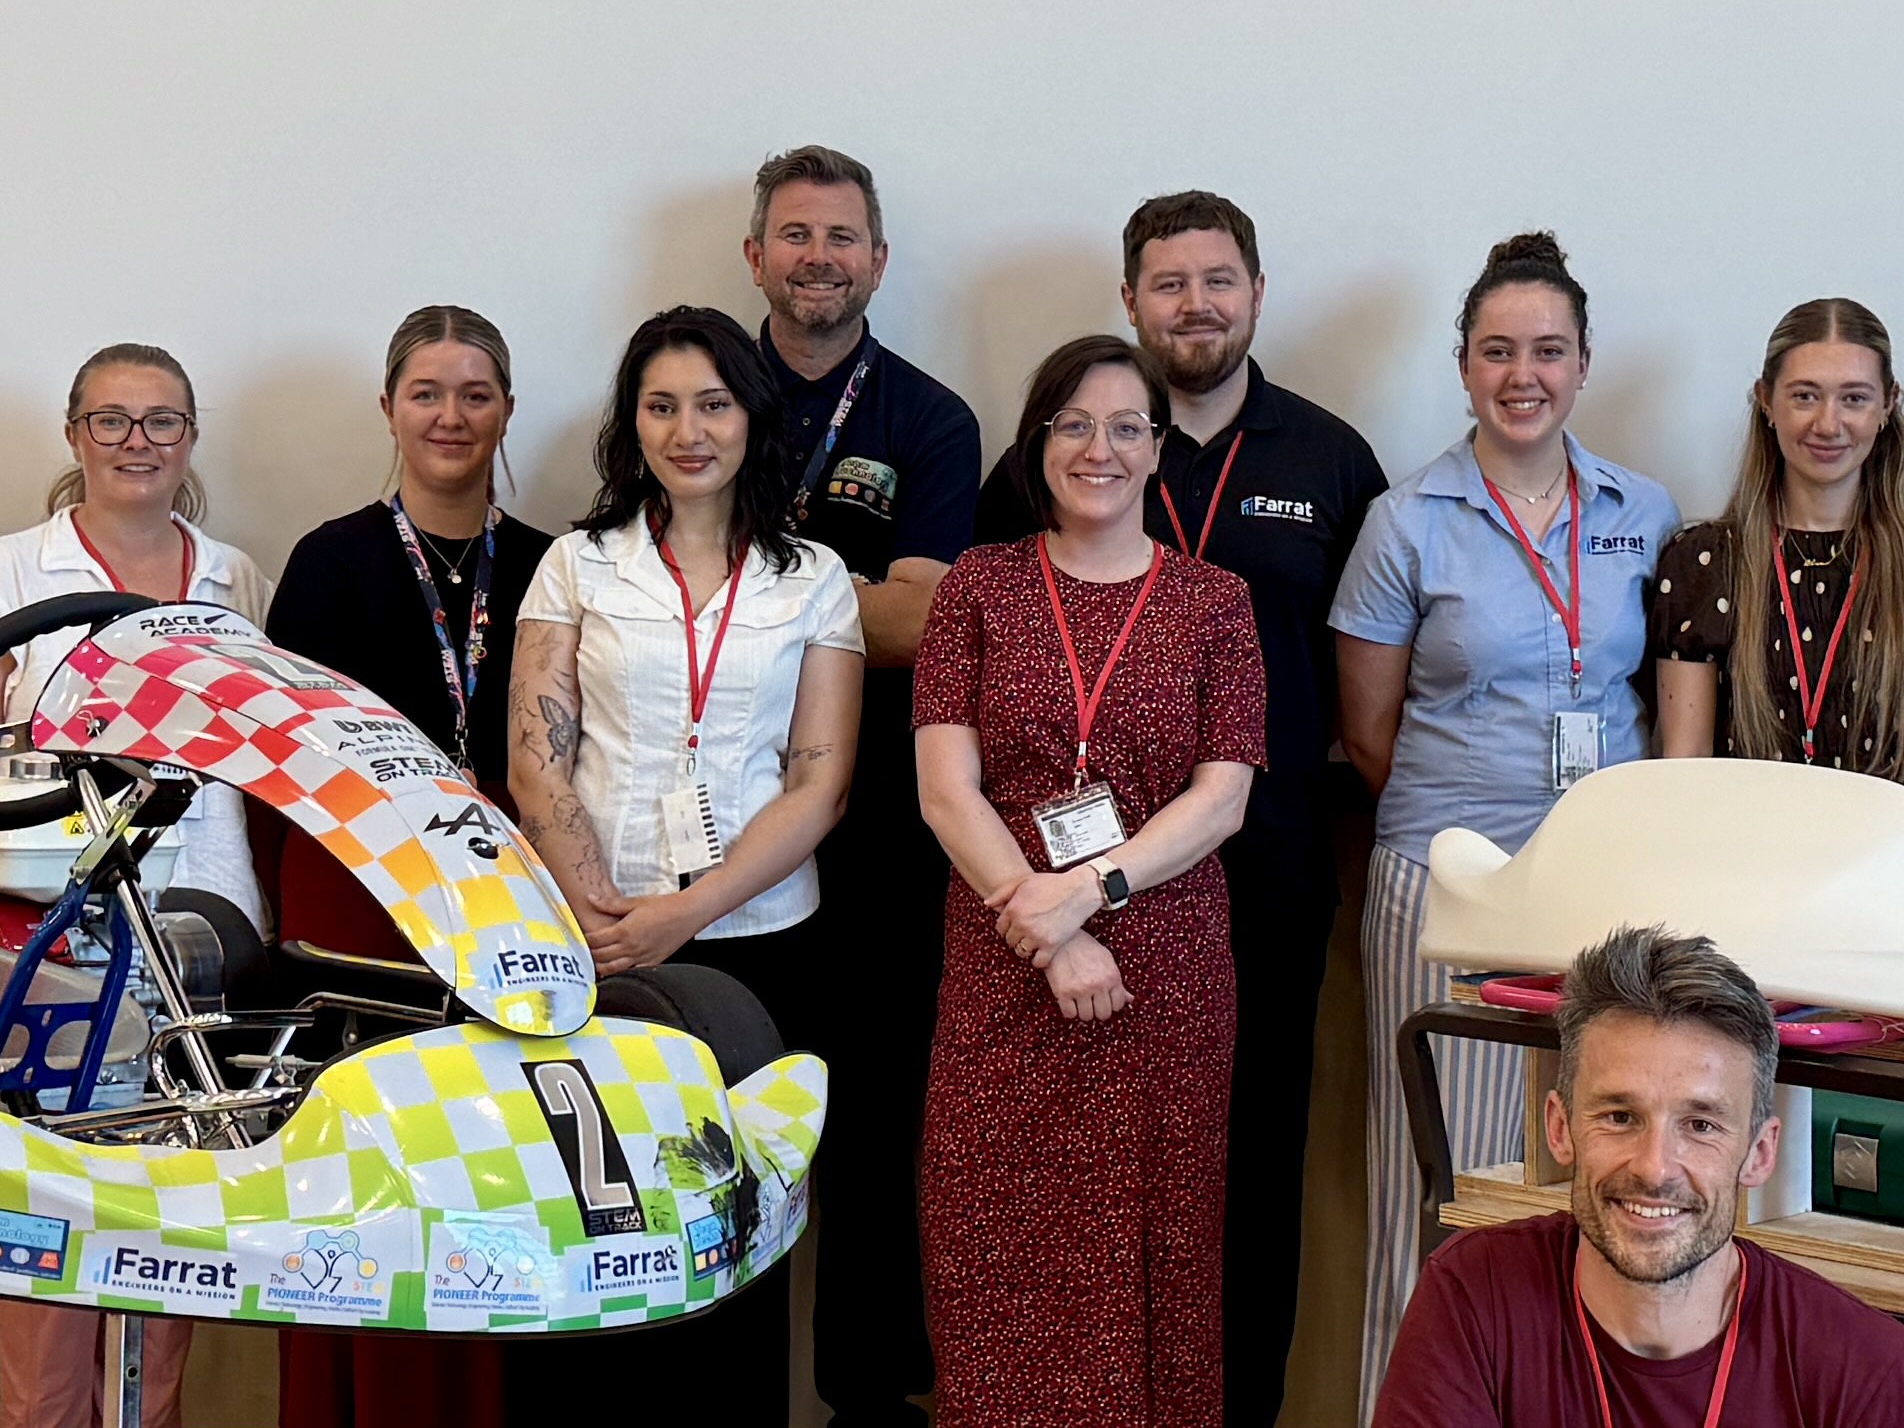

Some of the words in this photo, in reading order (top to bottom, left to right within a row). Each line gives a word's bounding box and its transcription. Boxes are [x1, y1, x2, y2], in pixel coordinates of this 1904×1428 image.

[1254, 495, 1313, 518] Farrat
[1590, 535, 1645, 551] Farrat
[139, 615, 200, 630] RACE
[150, 627, 252, 638] ACADEMY
[376, 770, 406, 782] ON
[498, 949, 585, 979] Farrat
[534, 1062, 635, 1211] 2
[589, 1208, 642, 1226] STEM
[114, 1246, 238, 1290] Farrat
[593, 1245, 679, 1280] Farrat
[270, 1272, 287, 1286] The
[435, 1274, 451, 1286] The
[595, 1279, 635, 1292] ENGINEERS
[637, 1277, 647, 1286] ON
[112, 1278, 165, 1293] ENGINEERS
[169, 1286, 182, 1294] ON
[196, 1289, 236, 1300] MISSION
[267, 1287, 316, 1303] PIONEER
[318, 1291, 383, 1307] Programme
[433, 1288, 479, 1301] PIONEER
[481, 1290, 540, 1305] Programme
